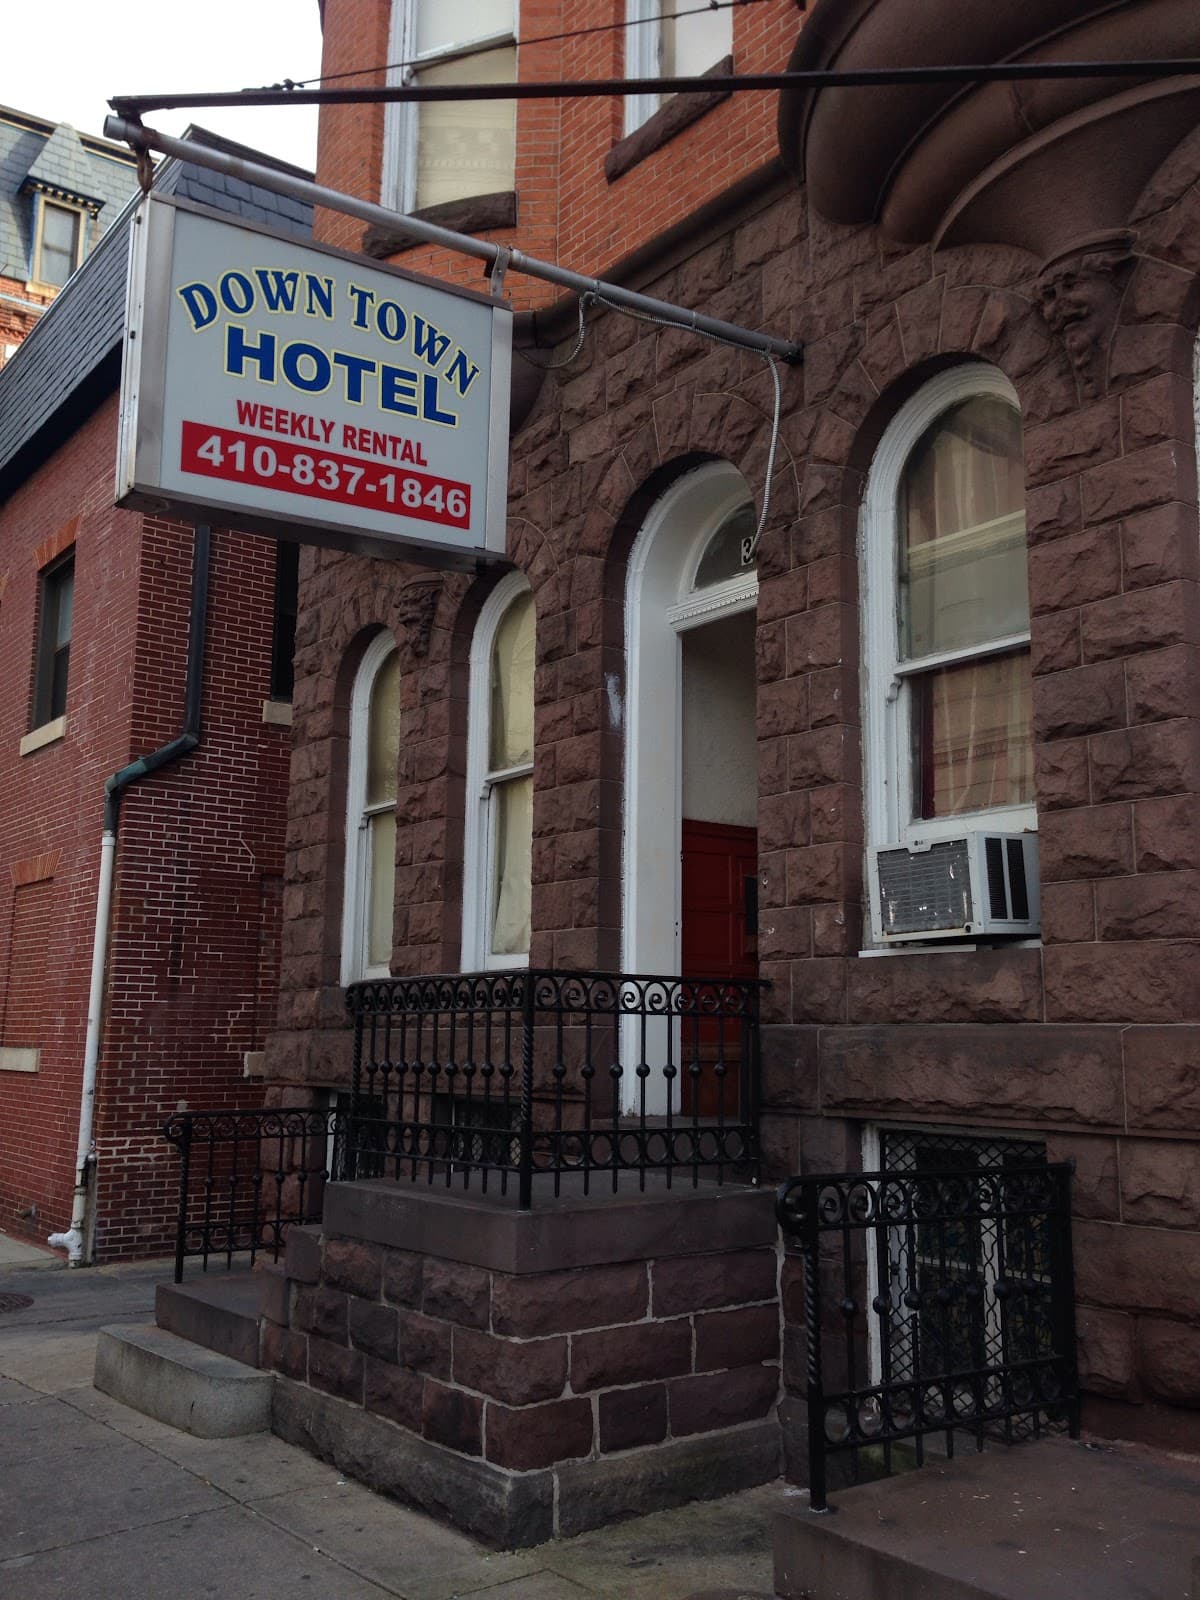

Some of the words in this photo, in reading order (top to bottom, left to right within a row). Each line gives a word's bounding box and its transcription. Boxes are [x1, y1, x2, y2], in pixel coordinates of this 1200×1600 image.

[177, 267, 336, 330] DOWN
[348, 283, 480, 396] TOWN
[224, 322, 459, 428] HOTEL
[196, 434, 468, 519] 410-837-1846
[236, 399, 336, 444] WEEKLY
[342, 424, 428, 467] RENTAL
